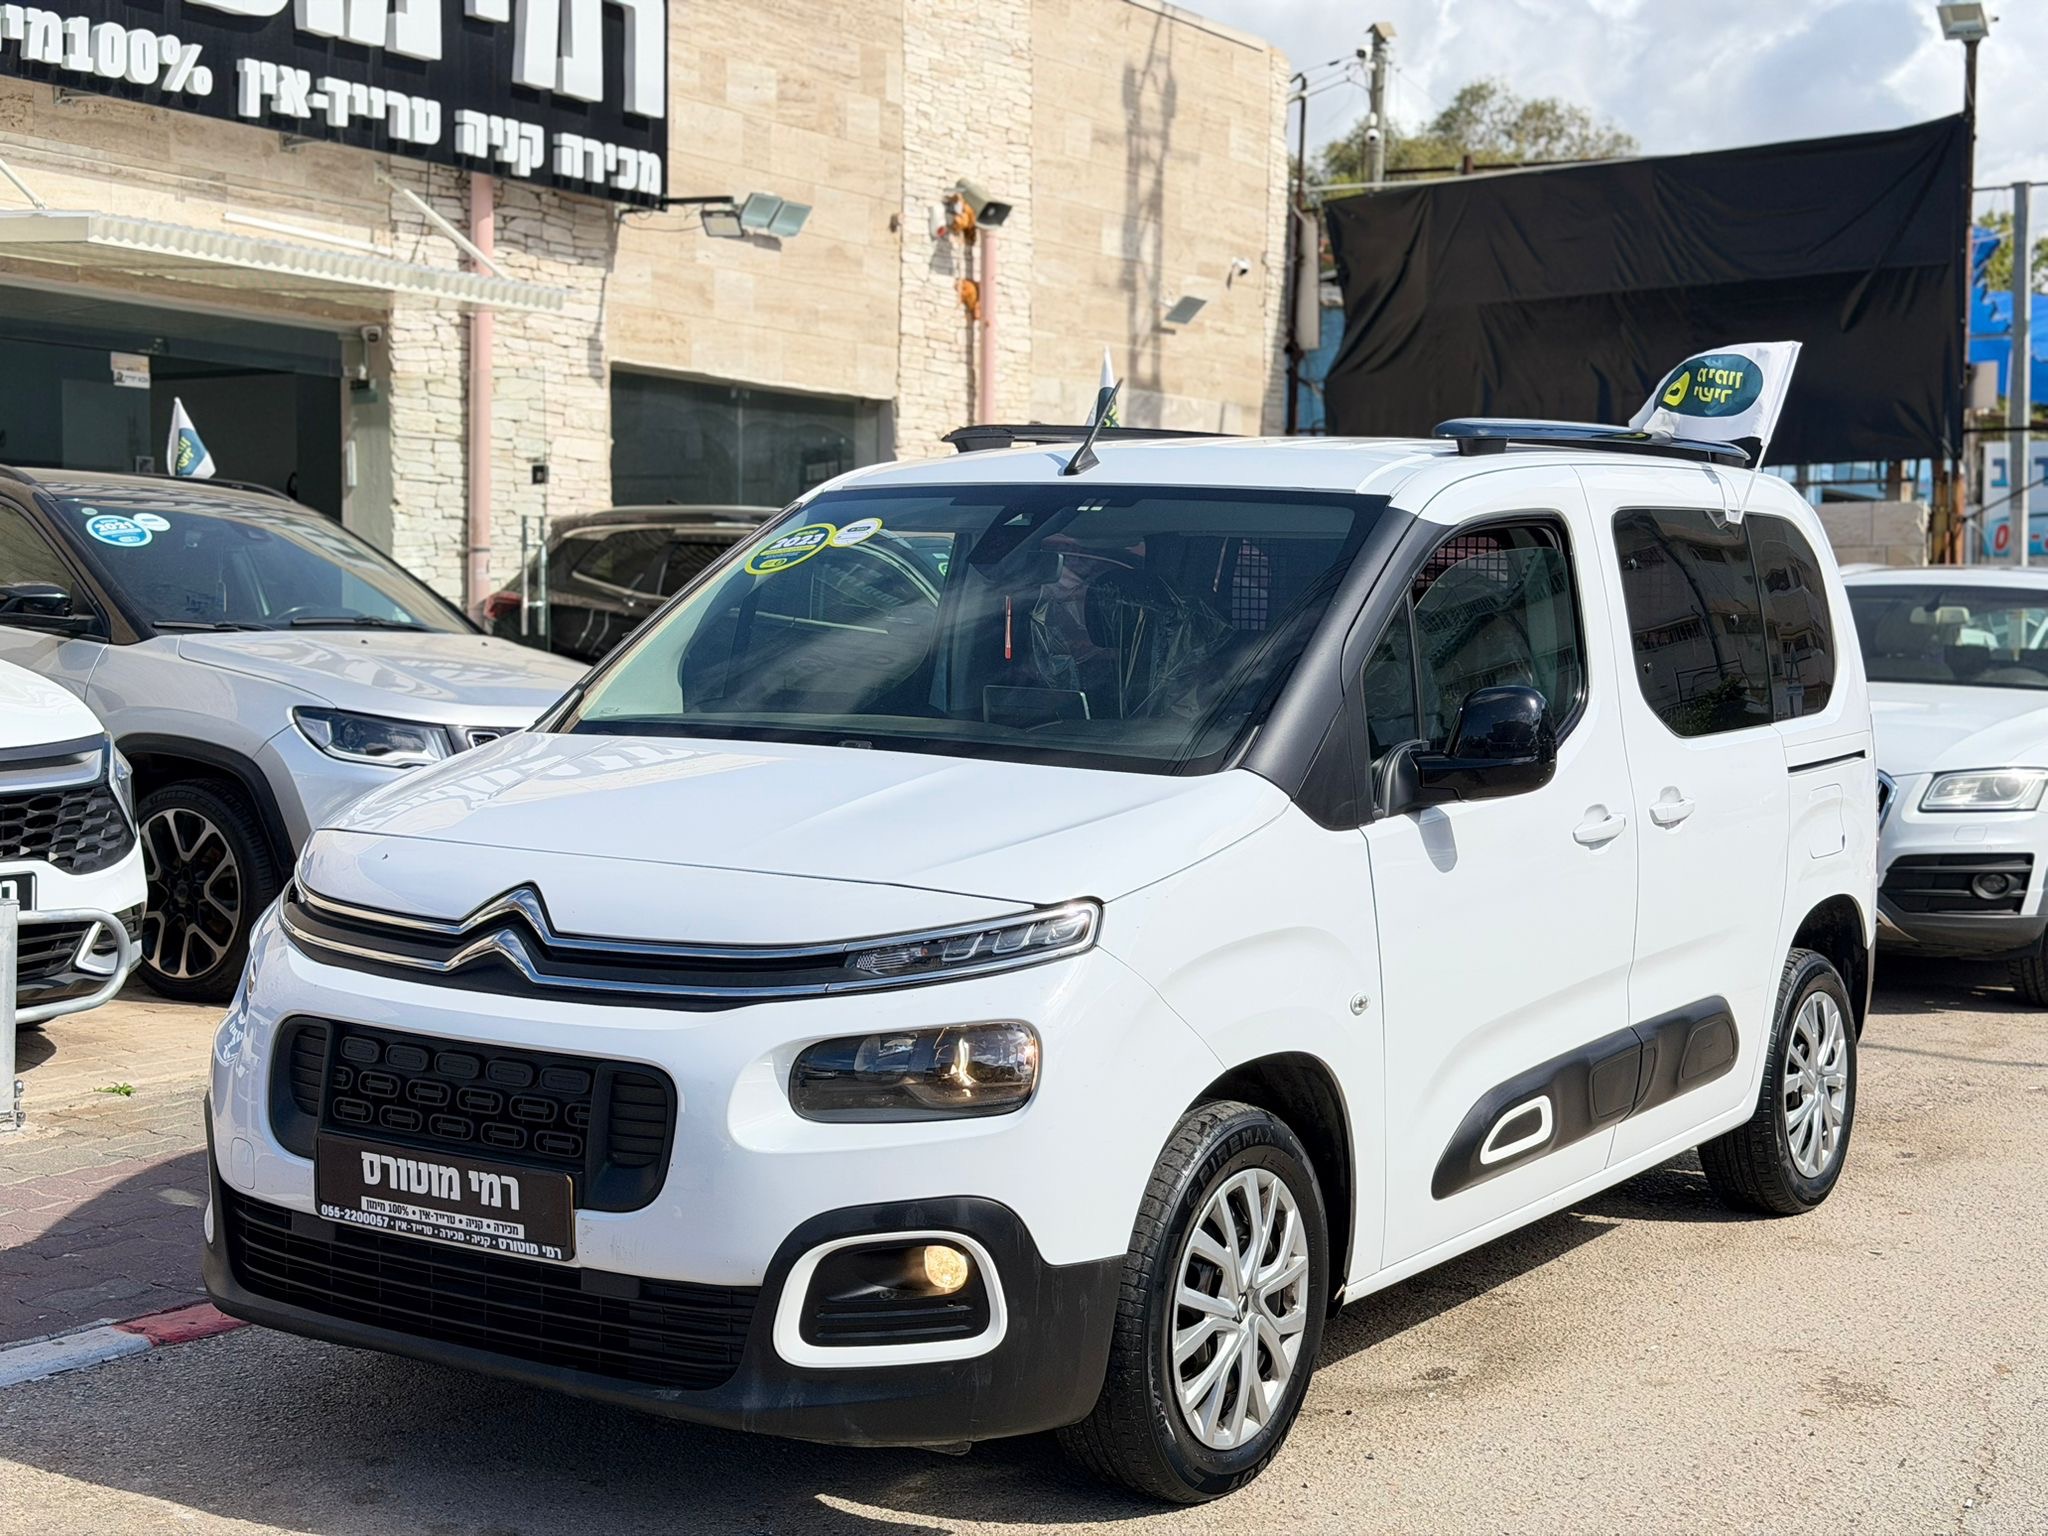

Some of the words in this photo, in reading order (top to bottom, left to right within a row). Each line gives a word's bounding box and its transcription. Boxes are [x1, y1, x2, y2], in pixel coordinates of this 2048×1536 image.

[236, 57, 441, 145] טרייד-אין
[454, 109, 544, 177] קניה
[552, 132, 662, 195] מכירה
[769, 533, 826, 550] 2023
[361, 1151, 461, 1201] מוטורס
[468, 1170, 520, 1210] רמי
[366, 1199, 386, 1211] מימון
[388, 1201, 409, 1216] 100%
[321, 1204, 389, 1228] 055-2200057
[465, 1218, 483, 1230] קניה
[440, 1228, 464, 1241] מכירה
[493, 1222, 519, 1236] מכירה
[471, 1234, 490, 1248] קניה
[498, 1238, 539, 1255] מוטורס
[542, 1245, 562, 1260] רמי
